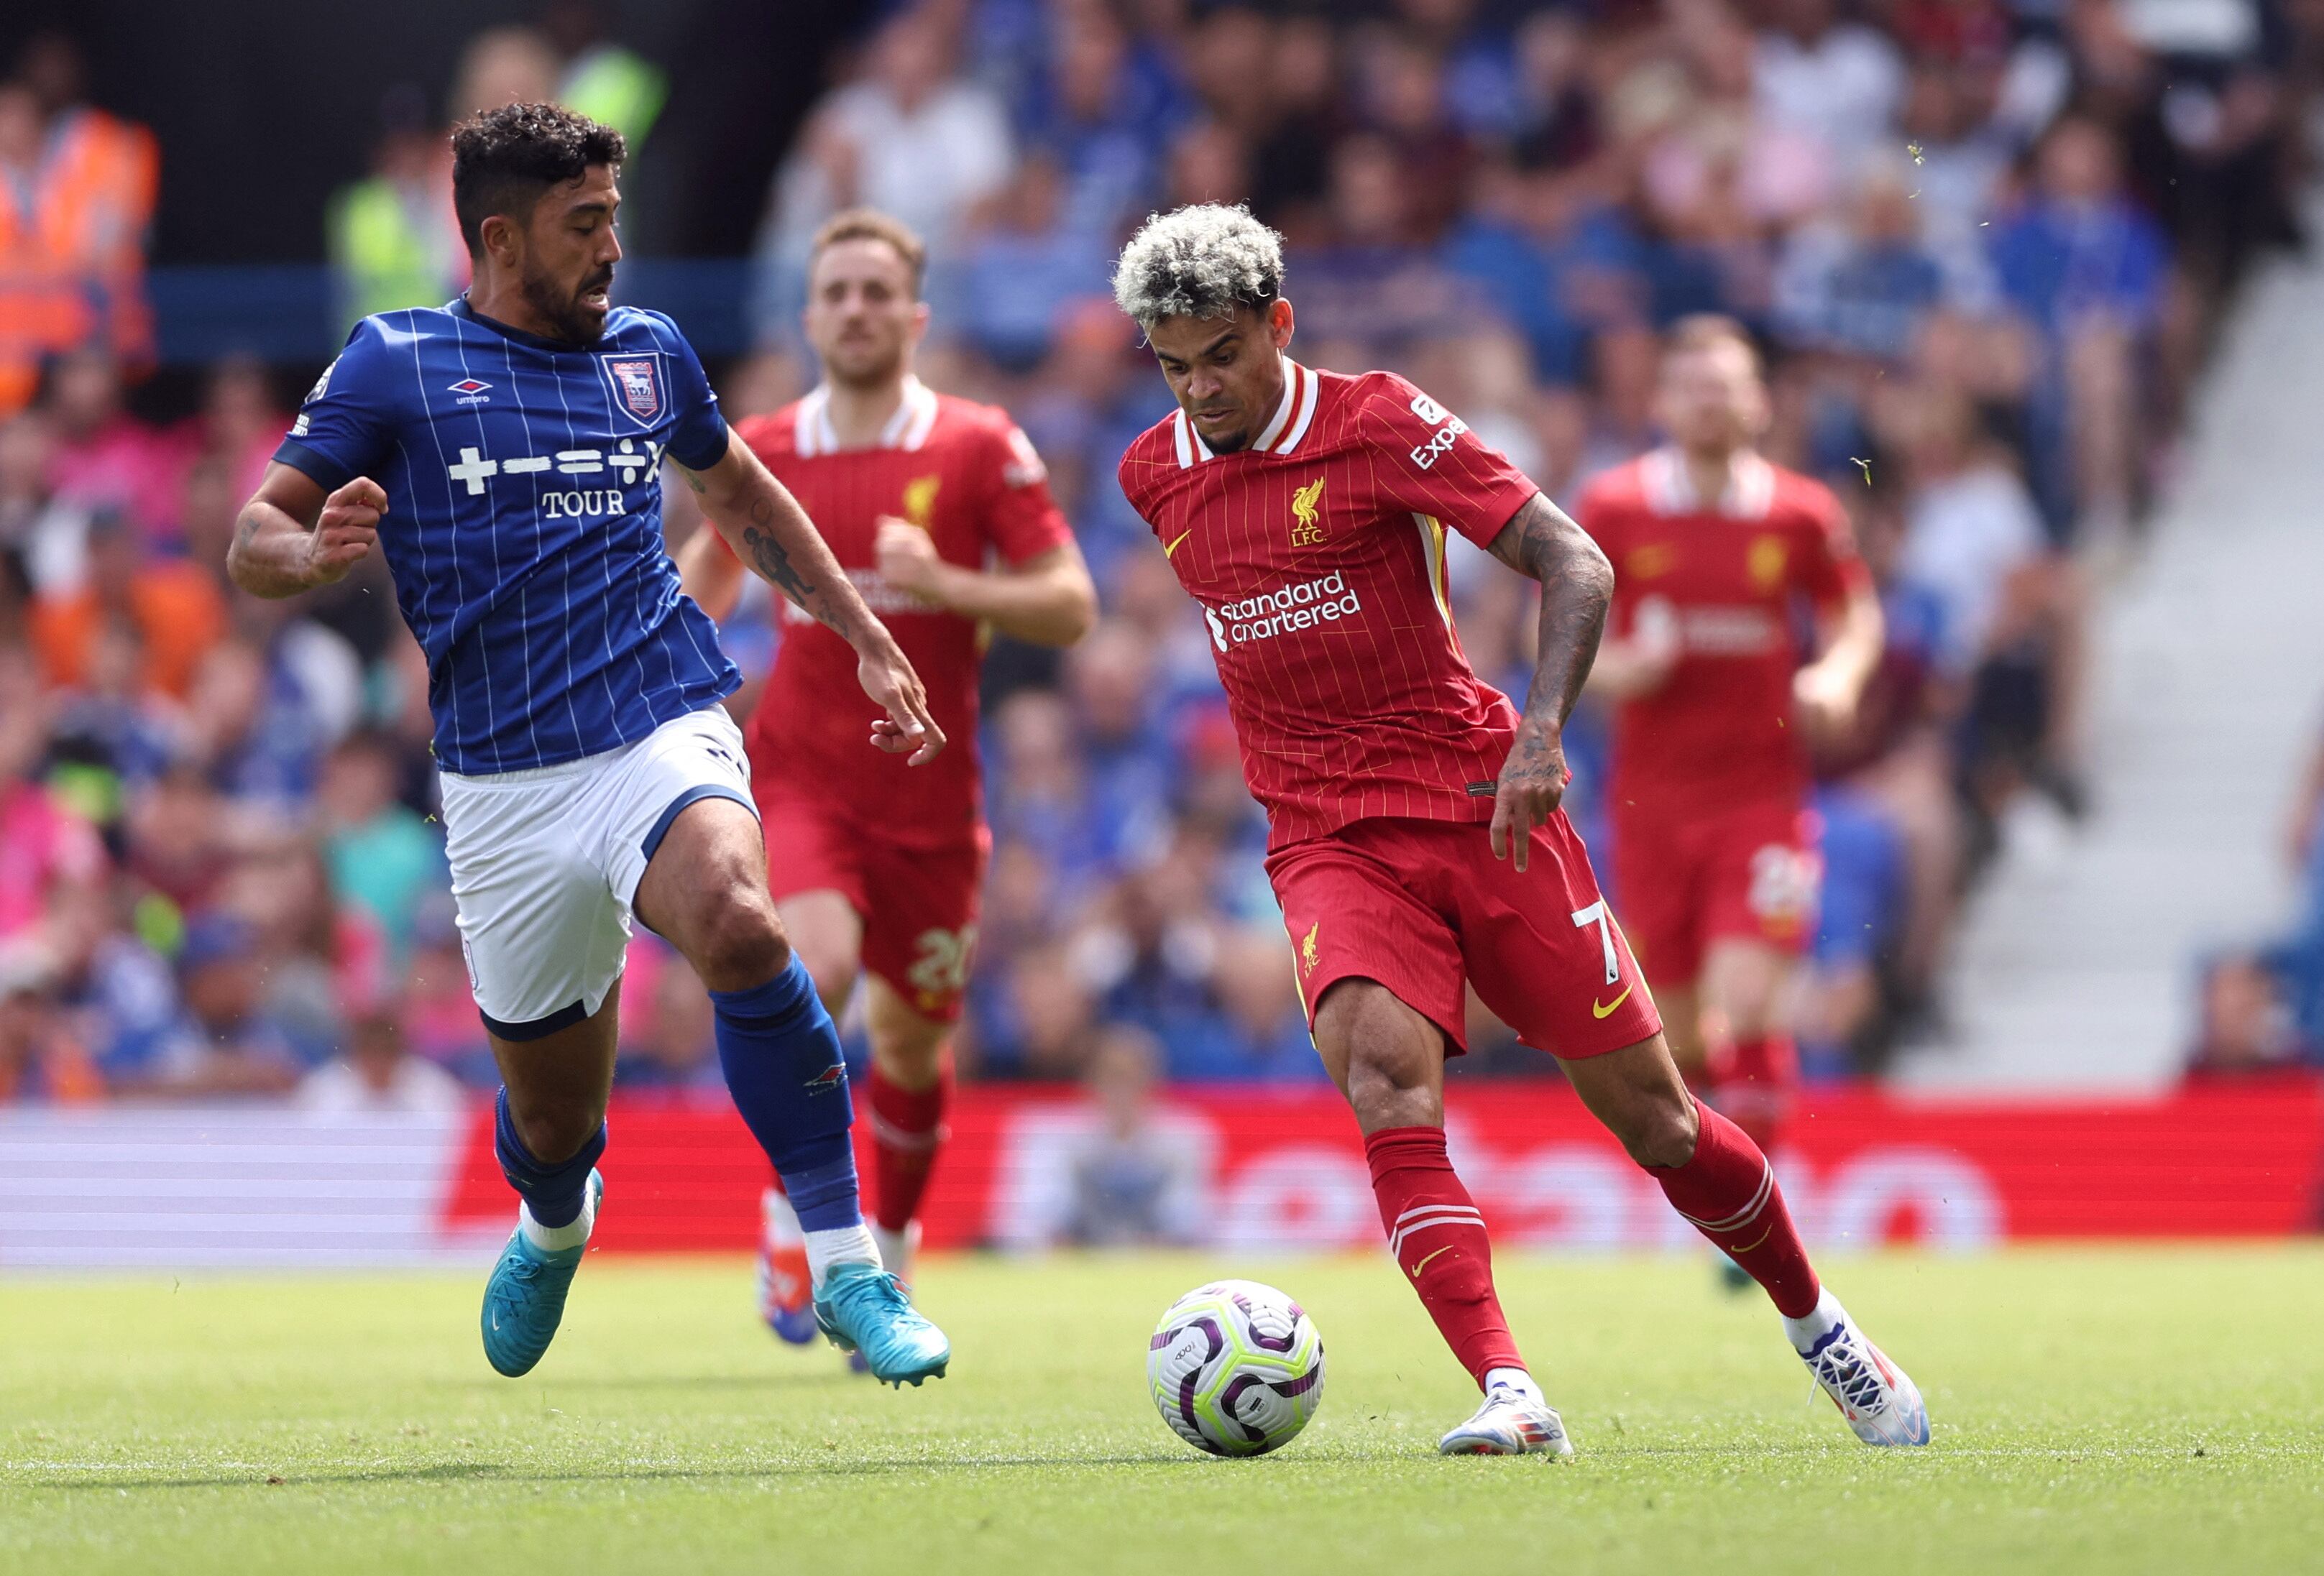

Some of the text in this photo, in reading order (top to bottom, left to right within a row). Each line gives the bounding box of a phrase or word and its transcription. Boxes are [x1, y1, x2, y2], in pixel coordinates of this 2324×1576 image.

[456, 394, 490, 405] umbro
[542, 489, 627, 519] TOUR
[1290, 529, 1328, 548] L.F.C.
[1220, 568, 1345, 621] standard
[1231, 589, 1361, 643] chartered
[1571, 900, 1620, 986] 7
